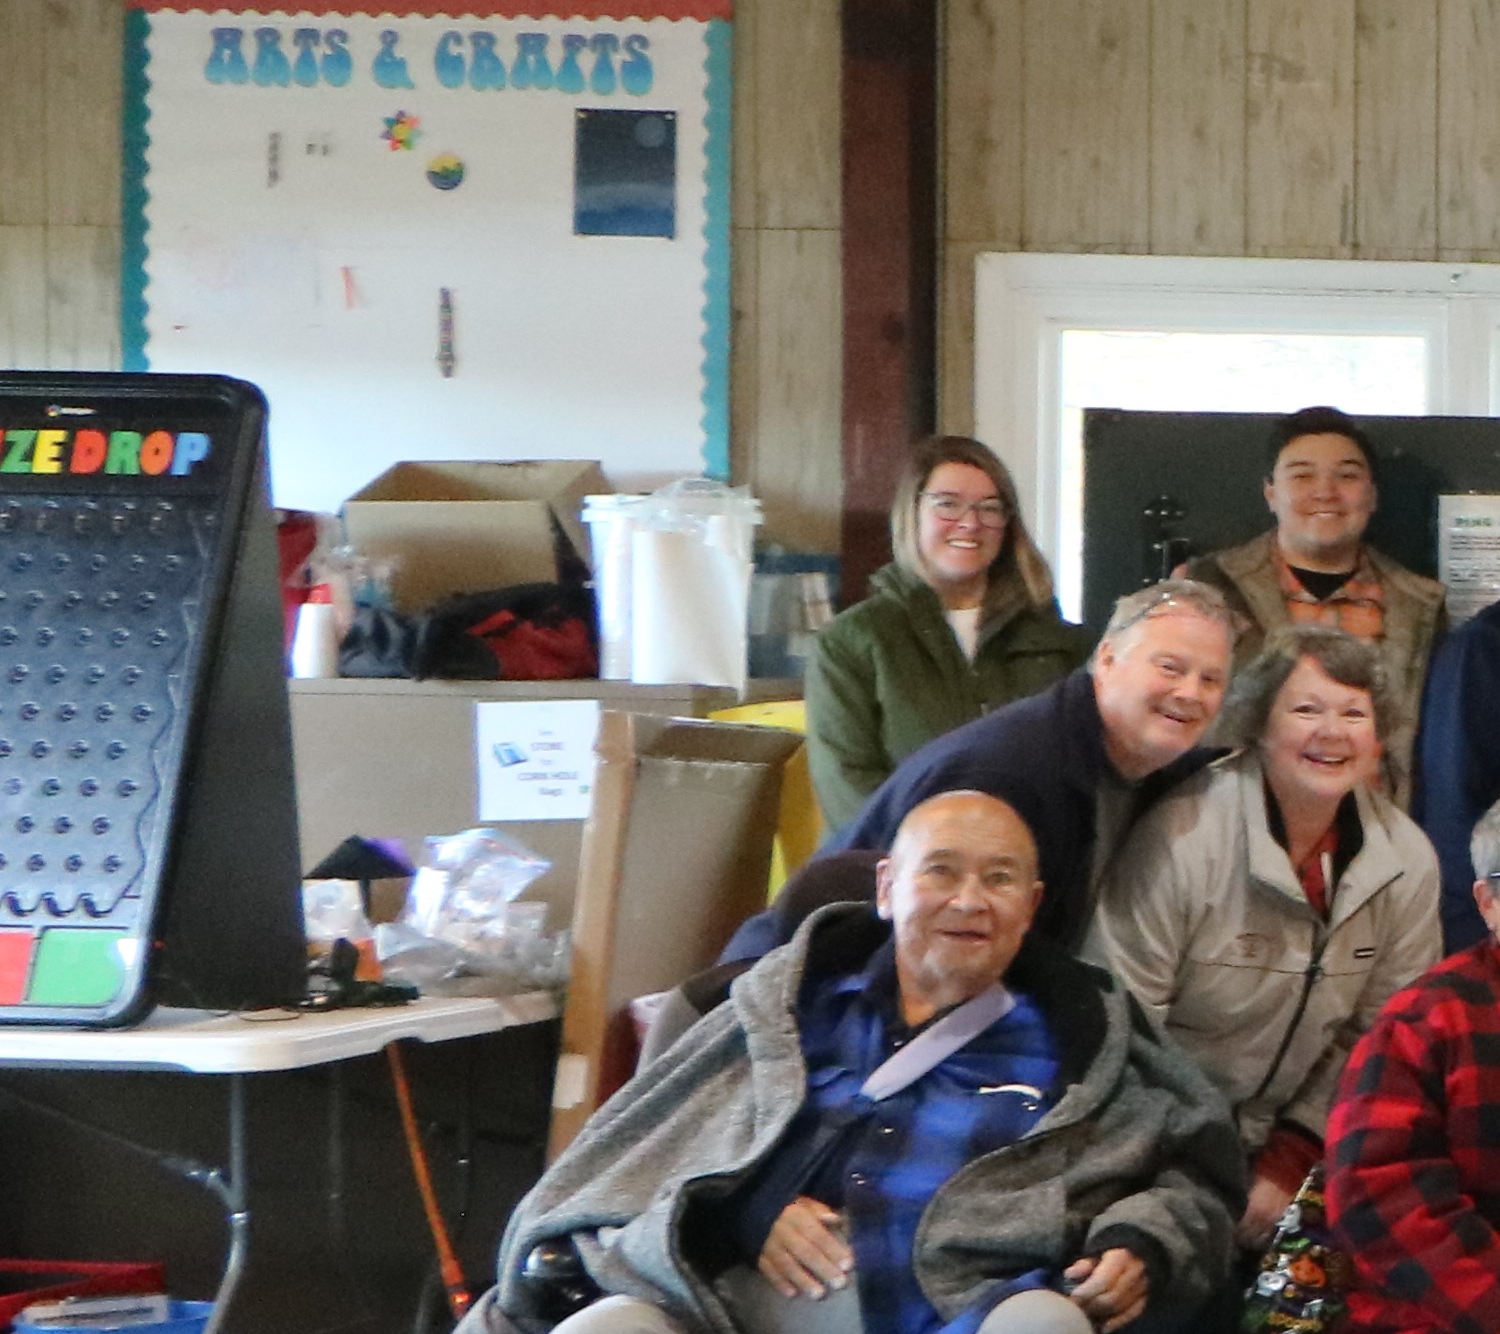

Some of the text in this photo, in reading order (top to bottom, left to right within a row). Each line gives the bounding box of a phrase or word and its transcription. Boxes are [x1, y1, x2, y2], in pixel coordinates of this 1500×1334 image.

[204, 27, 654, 96] ARTS & CRAFTS
[0, 429, 212, 476] ZE DROP
